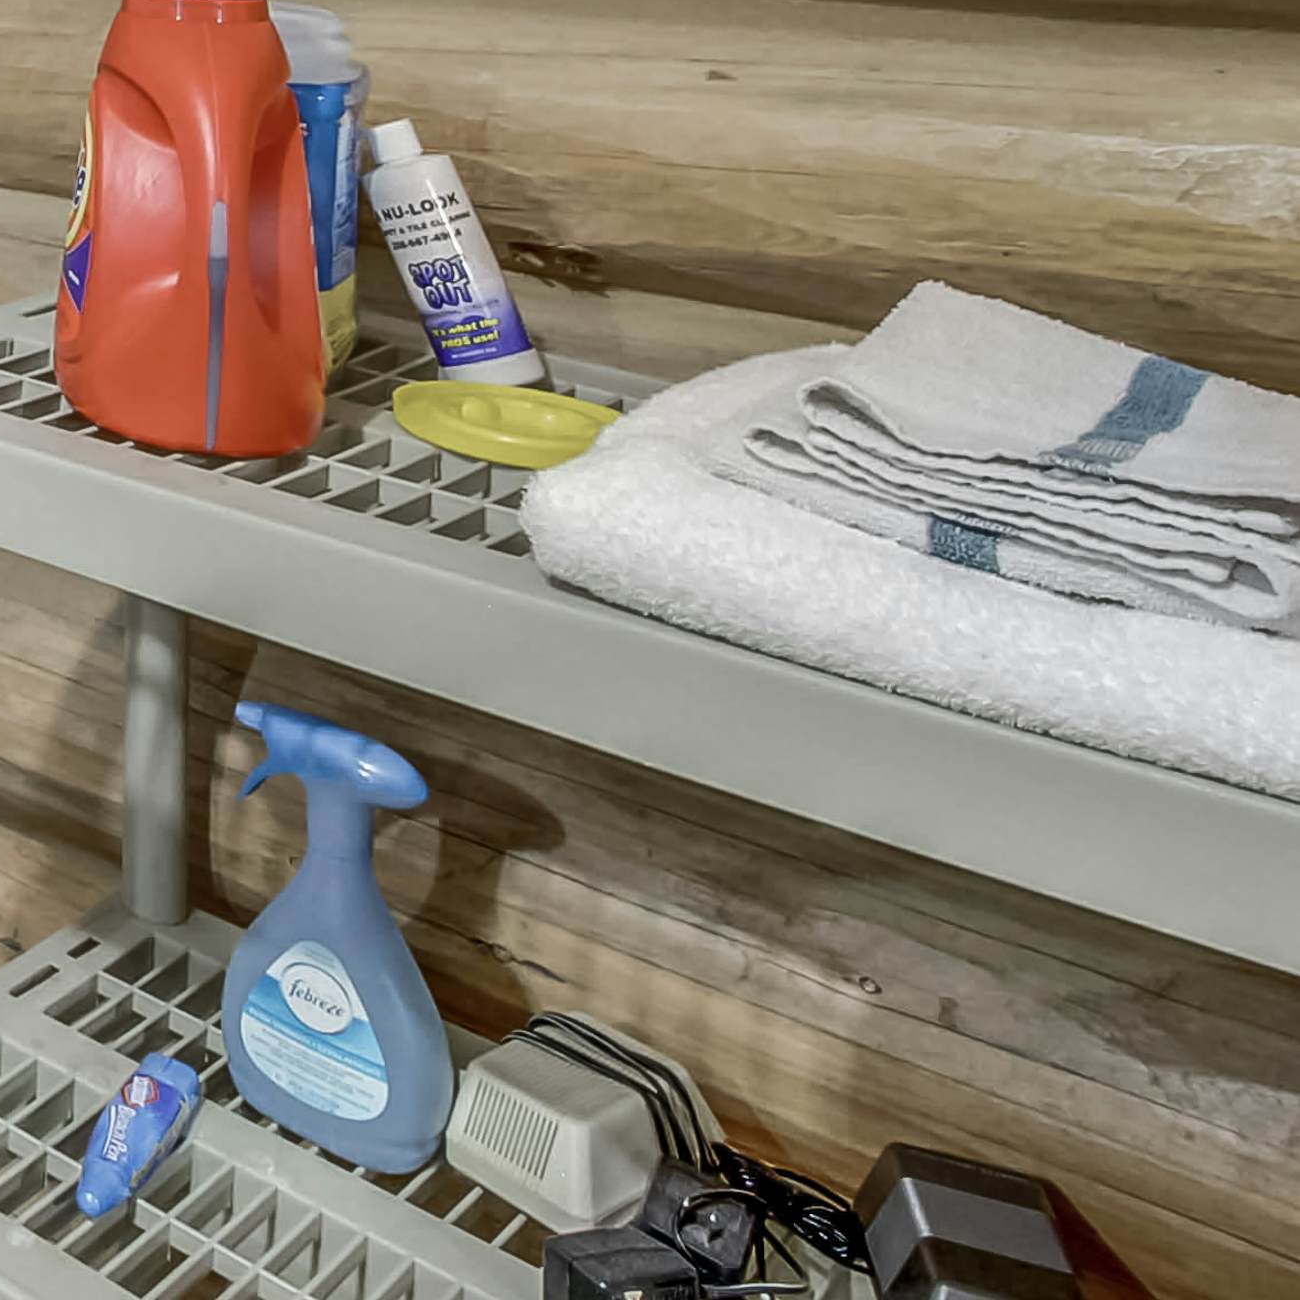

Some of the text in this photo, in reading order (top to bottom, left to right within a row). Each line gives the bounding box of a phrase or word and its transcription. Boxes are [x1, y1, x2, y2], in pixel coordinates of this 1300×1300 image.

[409, 254, 469, 289] SPOT
[423, 279, 472, 310] OUT
[448, 320, 477, 335] what
[479, 317, 500, 331] the
[288, 979, 345, 1018] febreze
